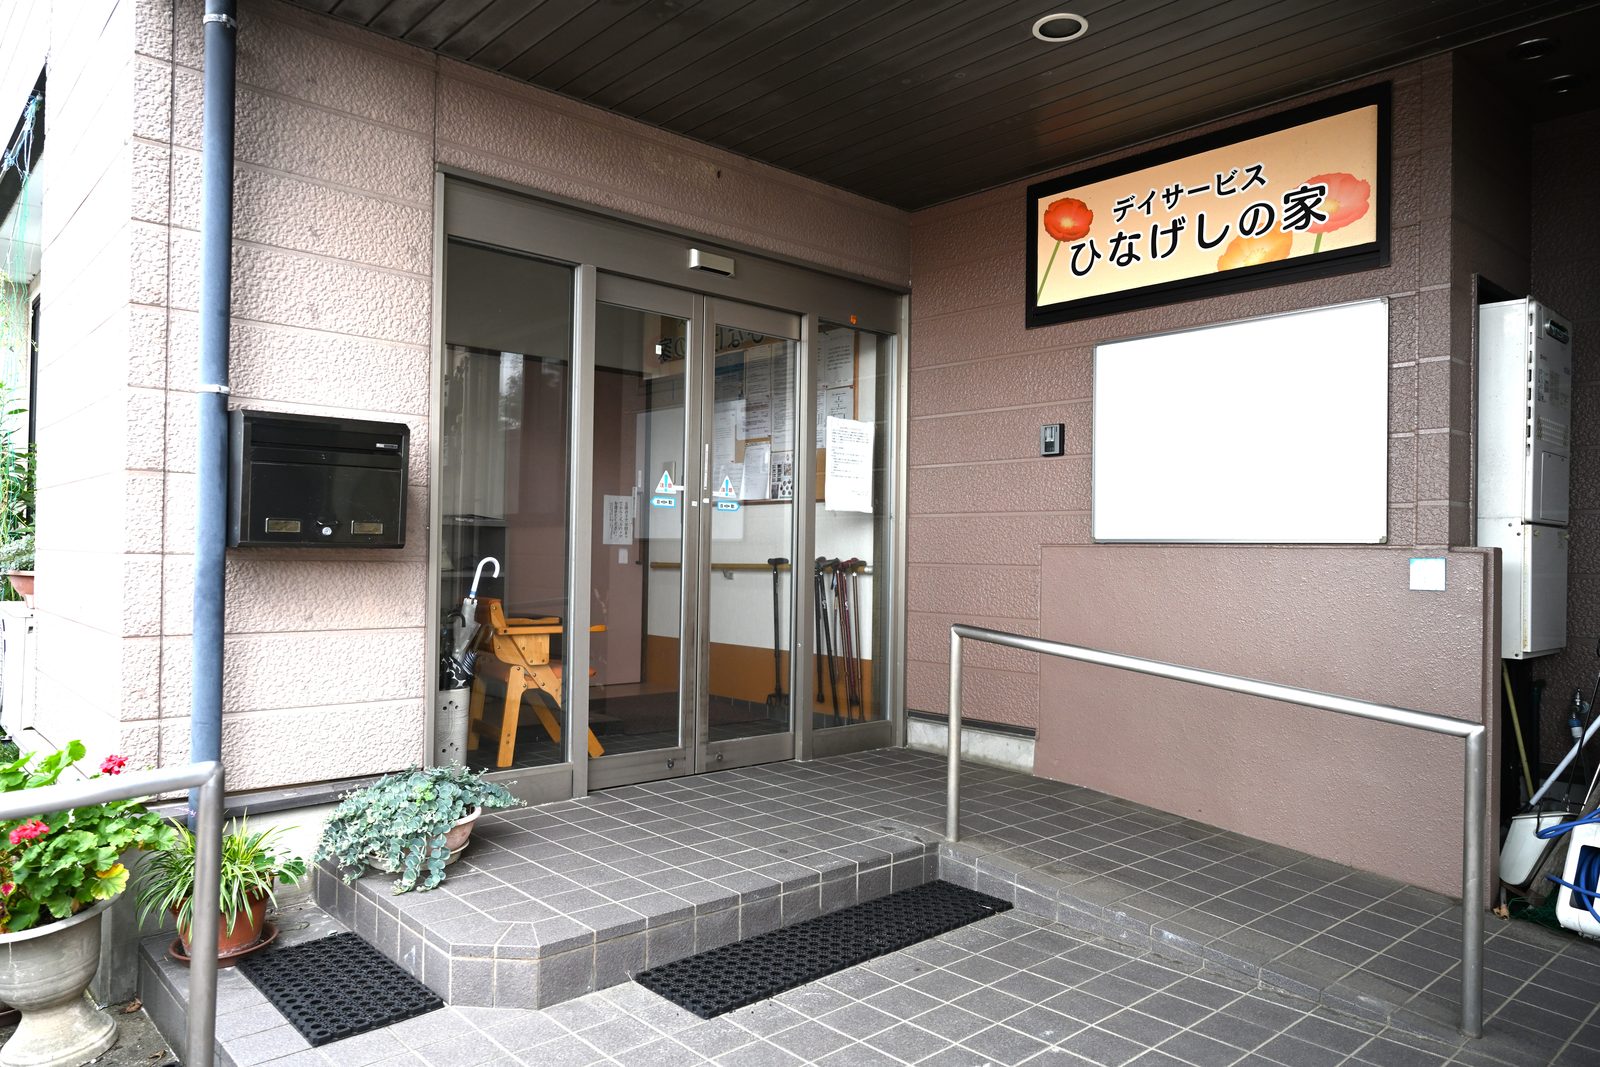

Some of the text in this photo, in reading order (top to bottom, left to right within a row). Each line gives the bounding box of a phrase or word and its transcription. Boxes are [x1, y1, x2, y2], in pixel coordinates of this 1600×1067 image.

[1113, 164, 1267, 222] デイサービス
[1070, 185, 1327, 276] ひなげしの家
